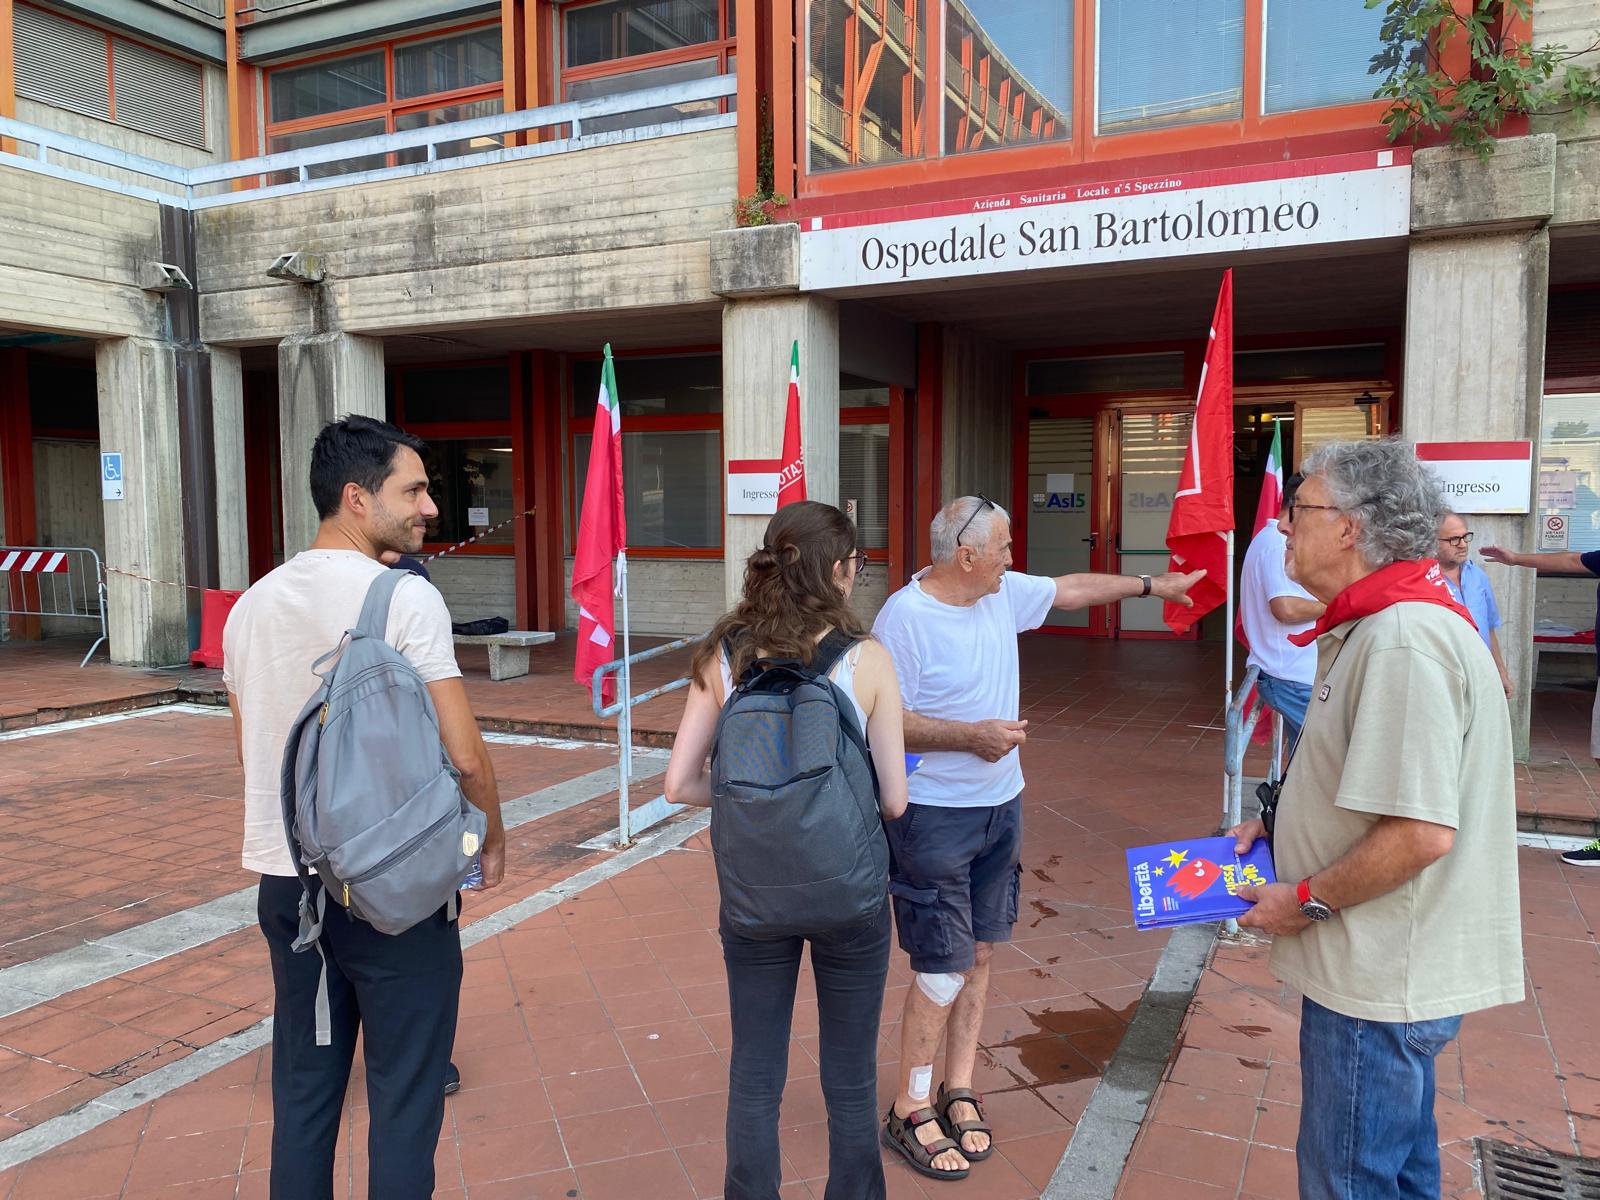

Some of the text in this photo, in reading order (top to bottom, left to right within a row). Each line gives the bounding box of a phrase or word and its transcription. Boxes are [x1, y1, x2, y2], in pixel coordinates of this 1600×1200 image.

[973, 197, 1011, 210] Azienda
[1020, 191, 1066, 205] Sanitaria
[1077, 185, 1110, 198] Locale
[1134, 178, 1182, 193] Spezzino
[861, 199, 1319, 278] Ospedale San Bartolomeo
[742, 489, 778, 501] Ingresso
[1442, 480, 1500, 497] Ingresso
[1047, 492, 1086, 508] Asl5
